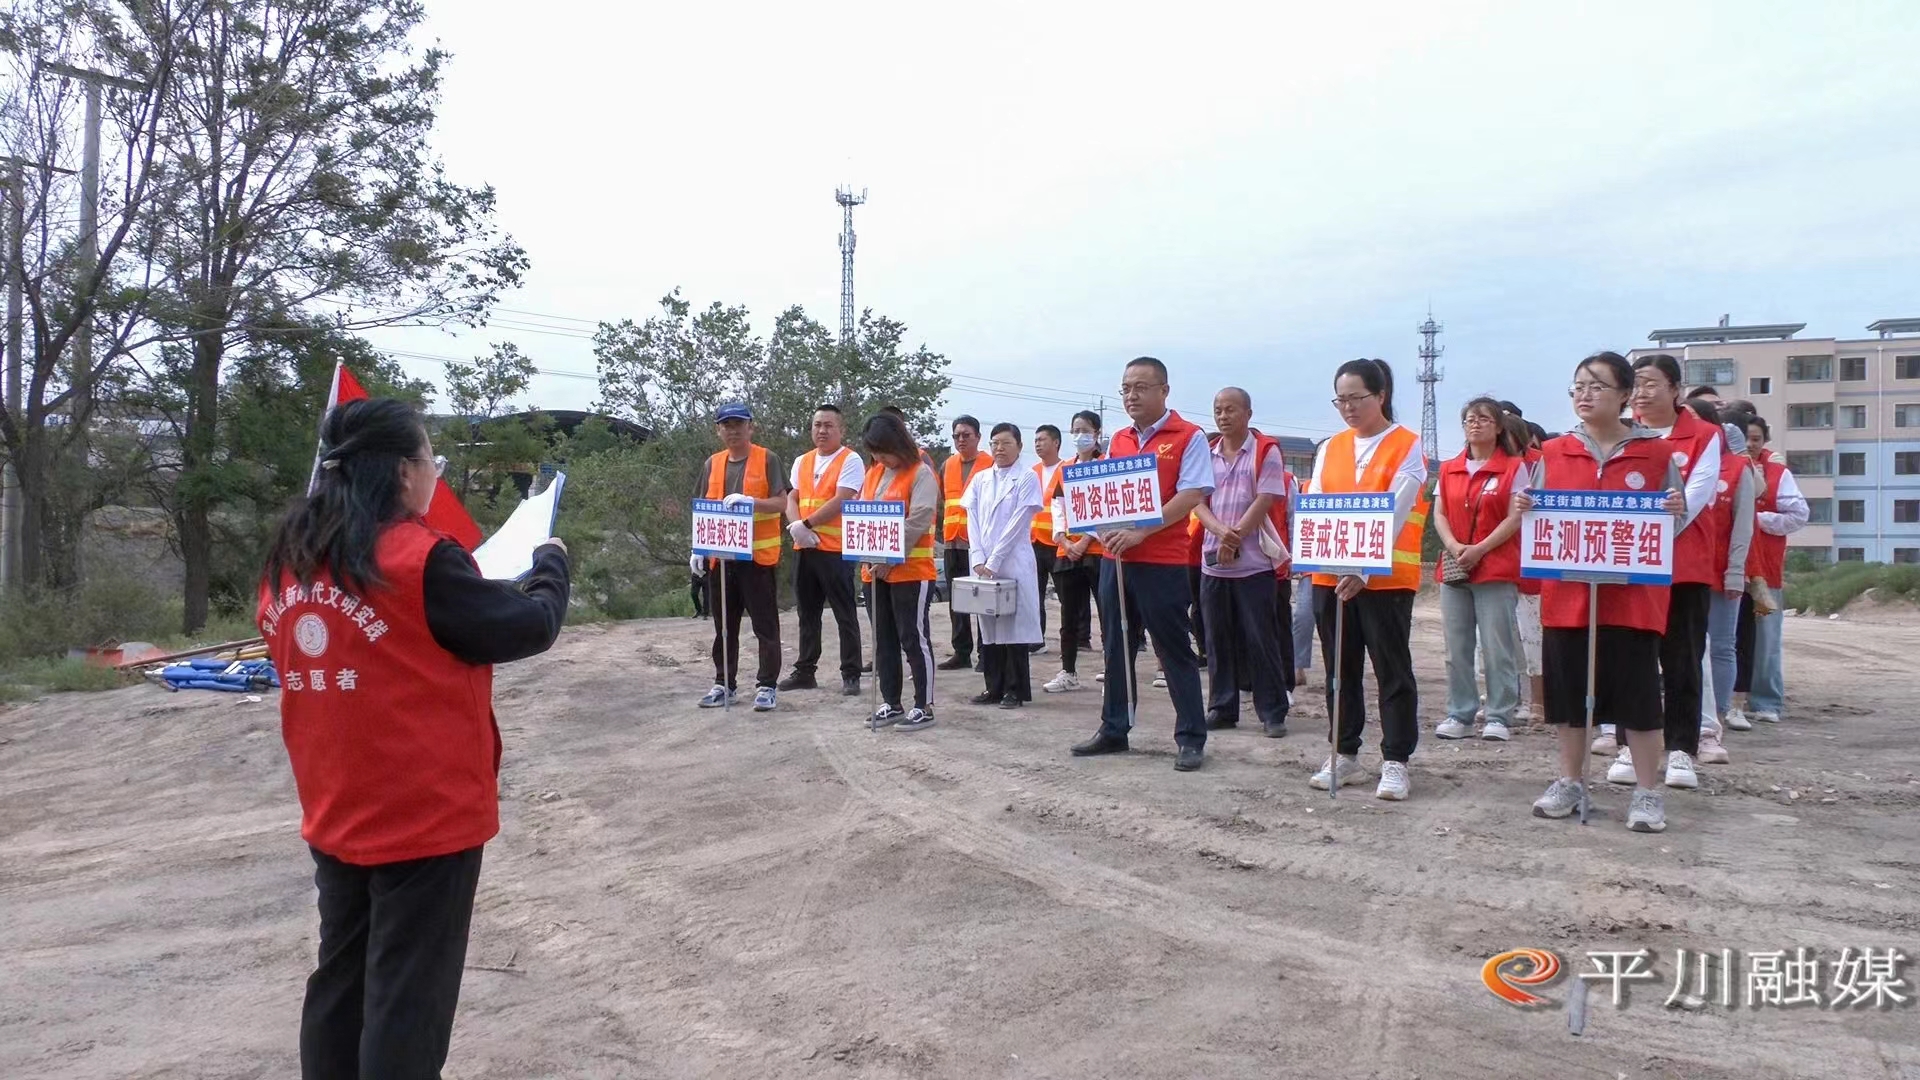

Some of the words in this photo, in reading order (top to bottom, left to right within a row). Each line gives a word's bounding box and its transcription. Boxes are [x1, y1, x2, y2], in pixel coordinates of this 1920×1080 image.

[1067, 457, 1152, 478] 长征街道防汛应急演练
[844, 503, 901, 514] 长征街道防汛应急演练
[1071, 478, 1155, 522] 物资供应组
[1300, 497, 1389, 509] 长征街道防汛应急演练
[696, 517, 748, 548] 抢险救灾组
[846, 520, 900, 551] 医疗救护组
[1299, 518, 1386, 559] 警戒保卫组
[1531, 518, 1662, 566] 监测预警组
[285, 668, 358, 691] 志愿者
